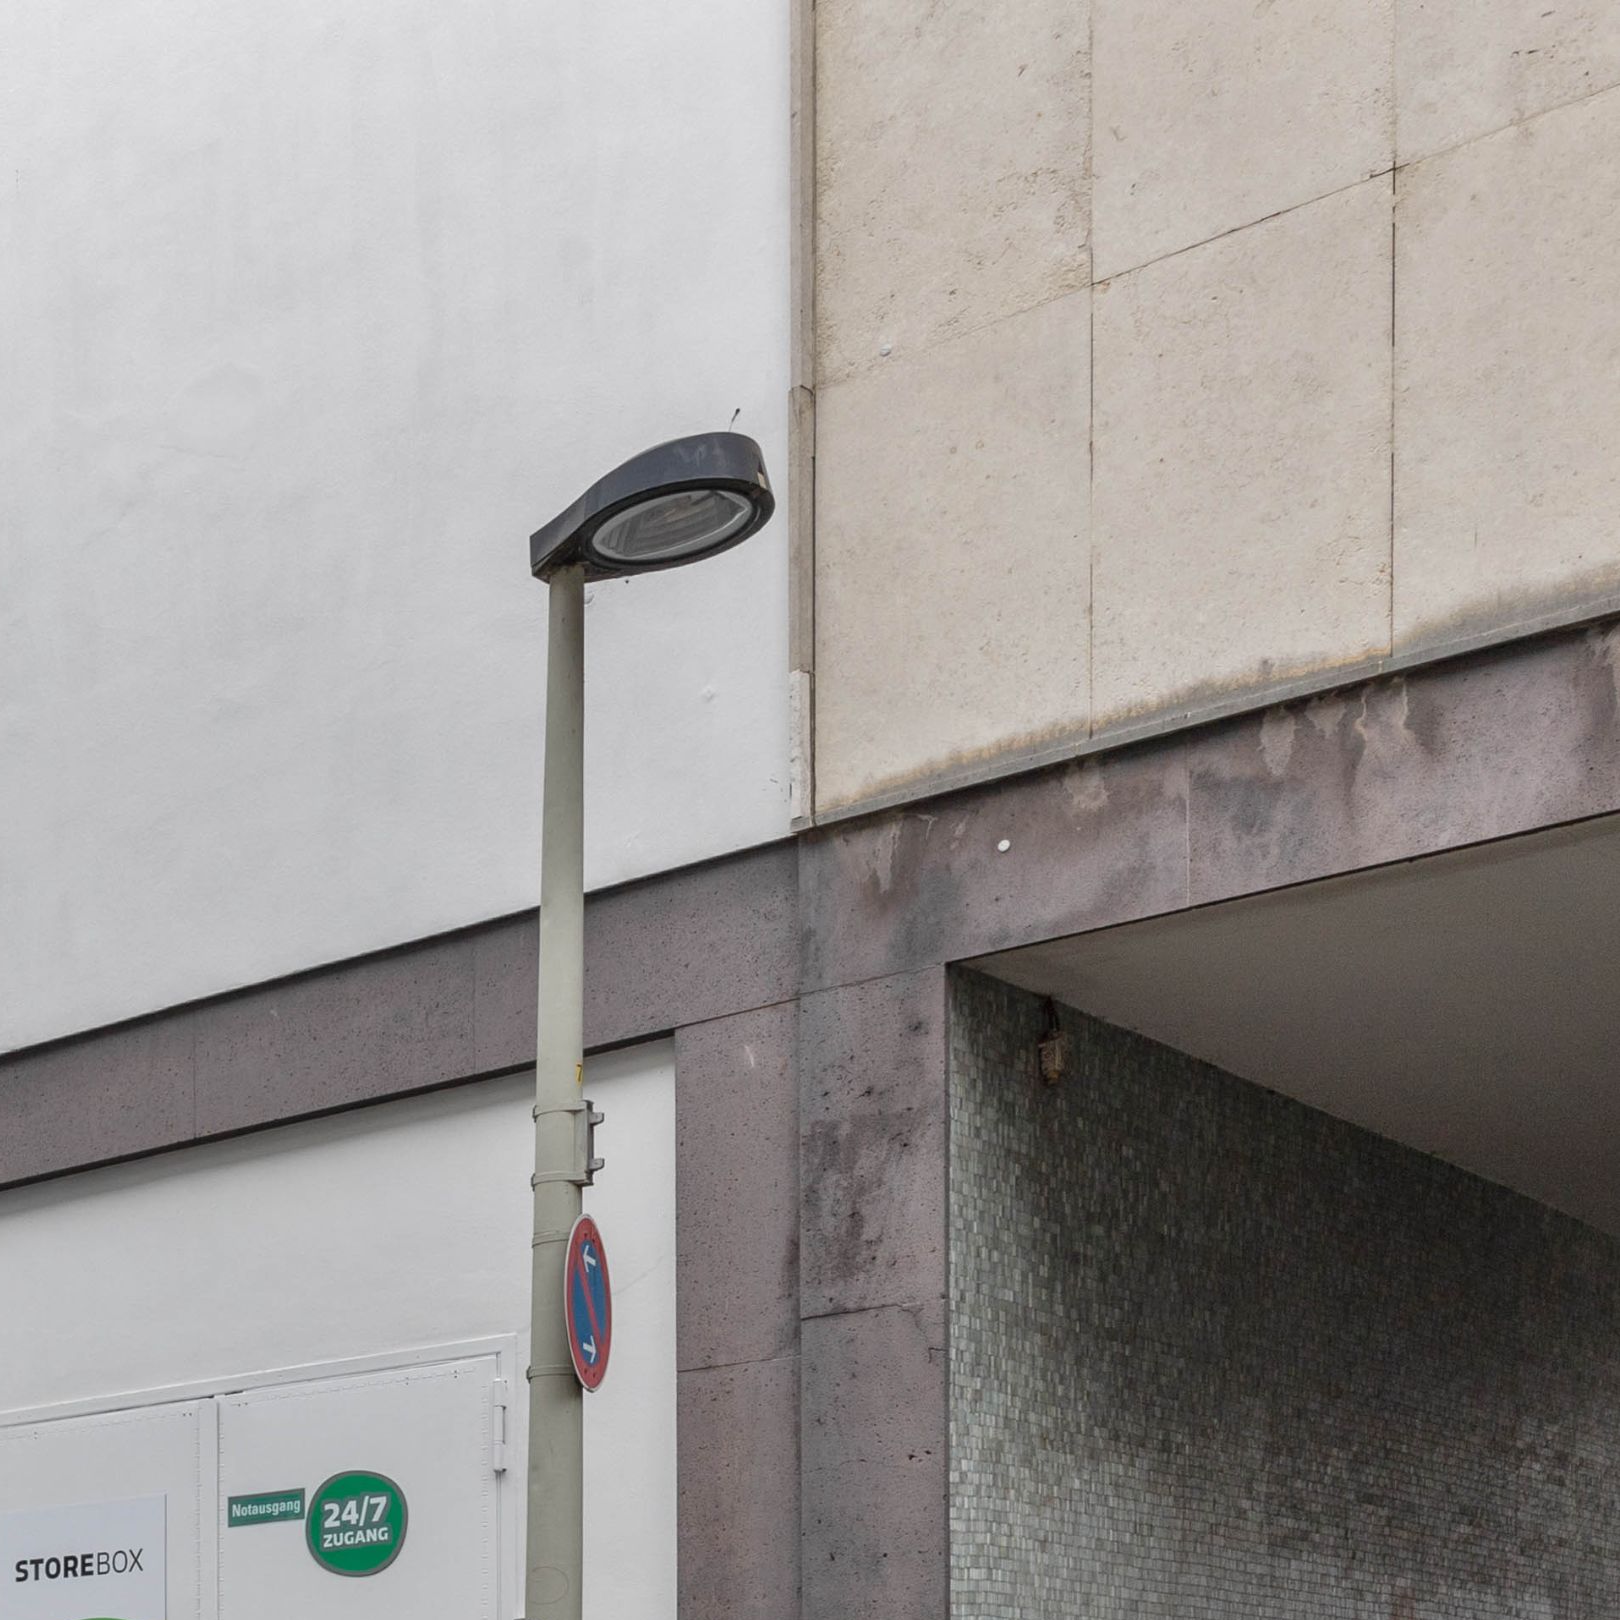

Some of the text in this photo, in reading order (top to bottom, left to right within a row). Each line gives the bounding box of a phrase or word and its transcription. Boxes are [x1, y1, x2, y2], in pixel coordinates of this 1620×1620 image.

[231, 1499, 301, 1518] Notausgang
[323, 1495, 388, 1529] 24/7
[323, 1527, 389, 1548] ZUGANG
[14, 1547, 144, 1583] STOREBOX
